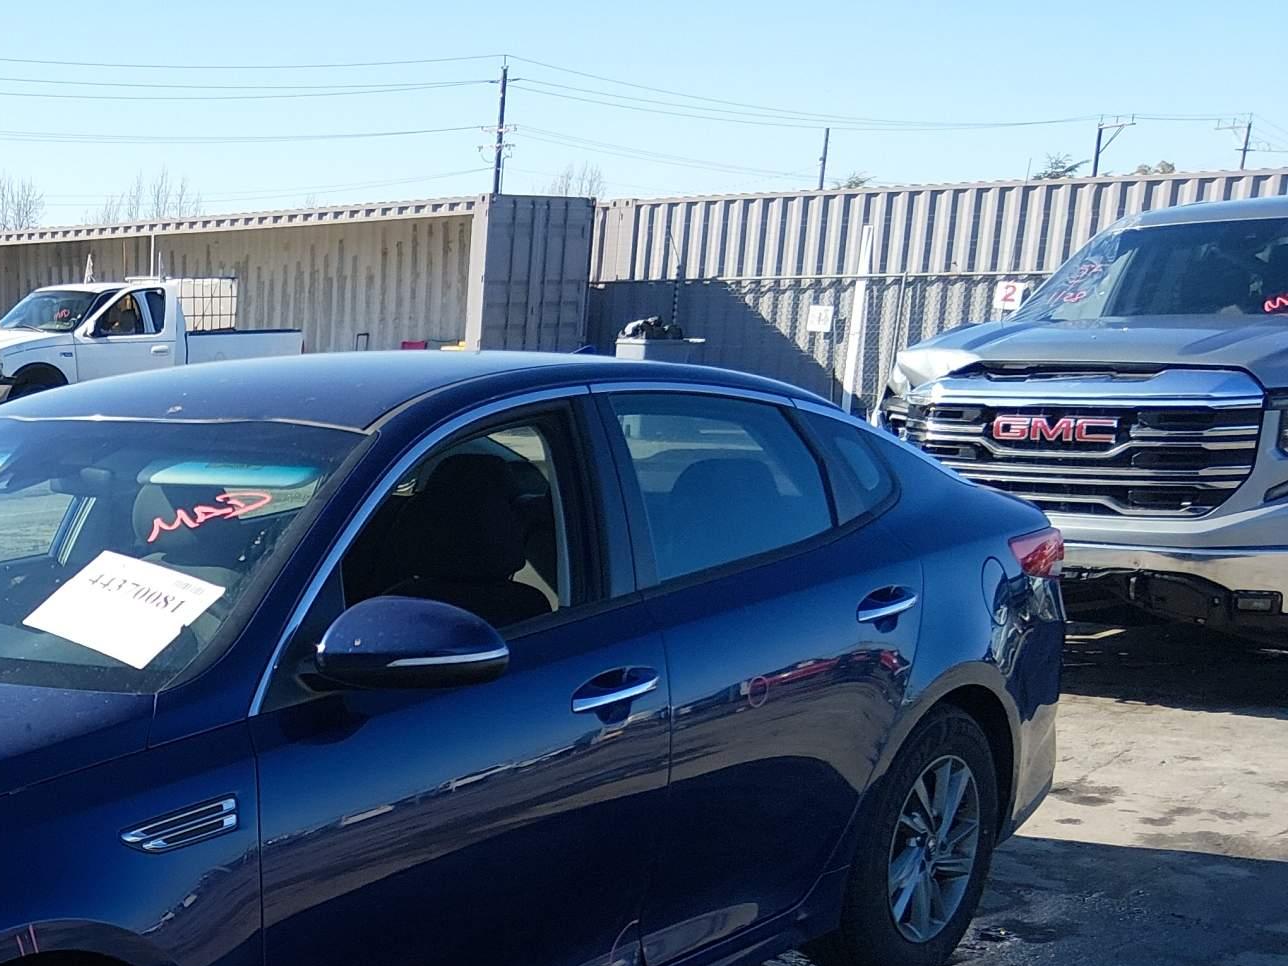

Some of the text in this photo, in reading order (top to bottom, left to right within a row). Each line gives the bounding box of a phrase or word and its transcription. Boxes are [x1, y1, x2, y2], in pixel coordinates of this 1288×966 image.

[1001, 284, 1017, 303] 2
[993, 415, 1119, 443] GMC
[147, 491, 272, 544] MAD
[88, 573, 186, 614] 44370081
